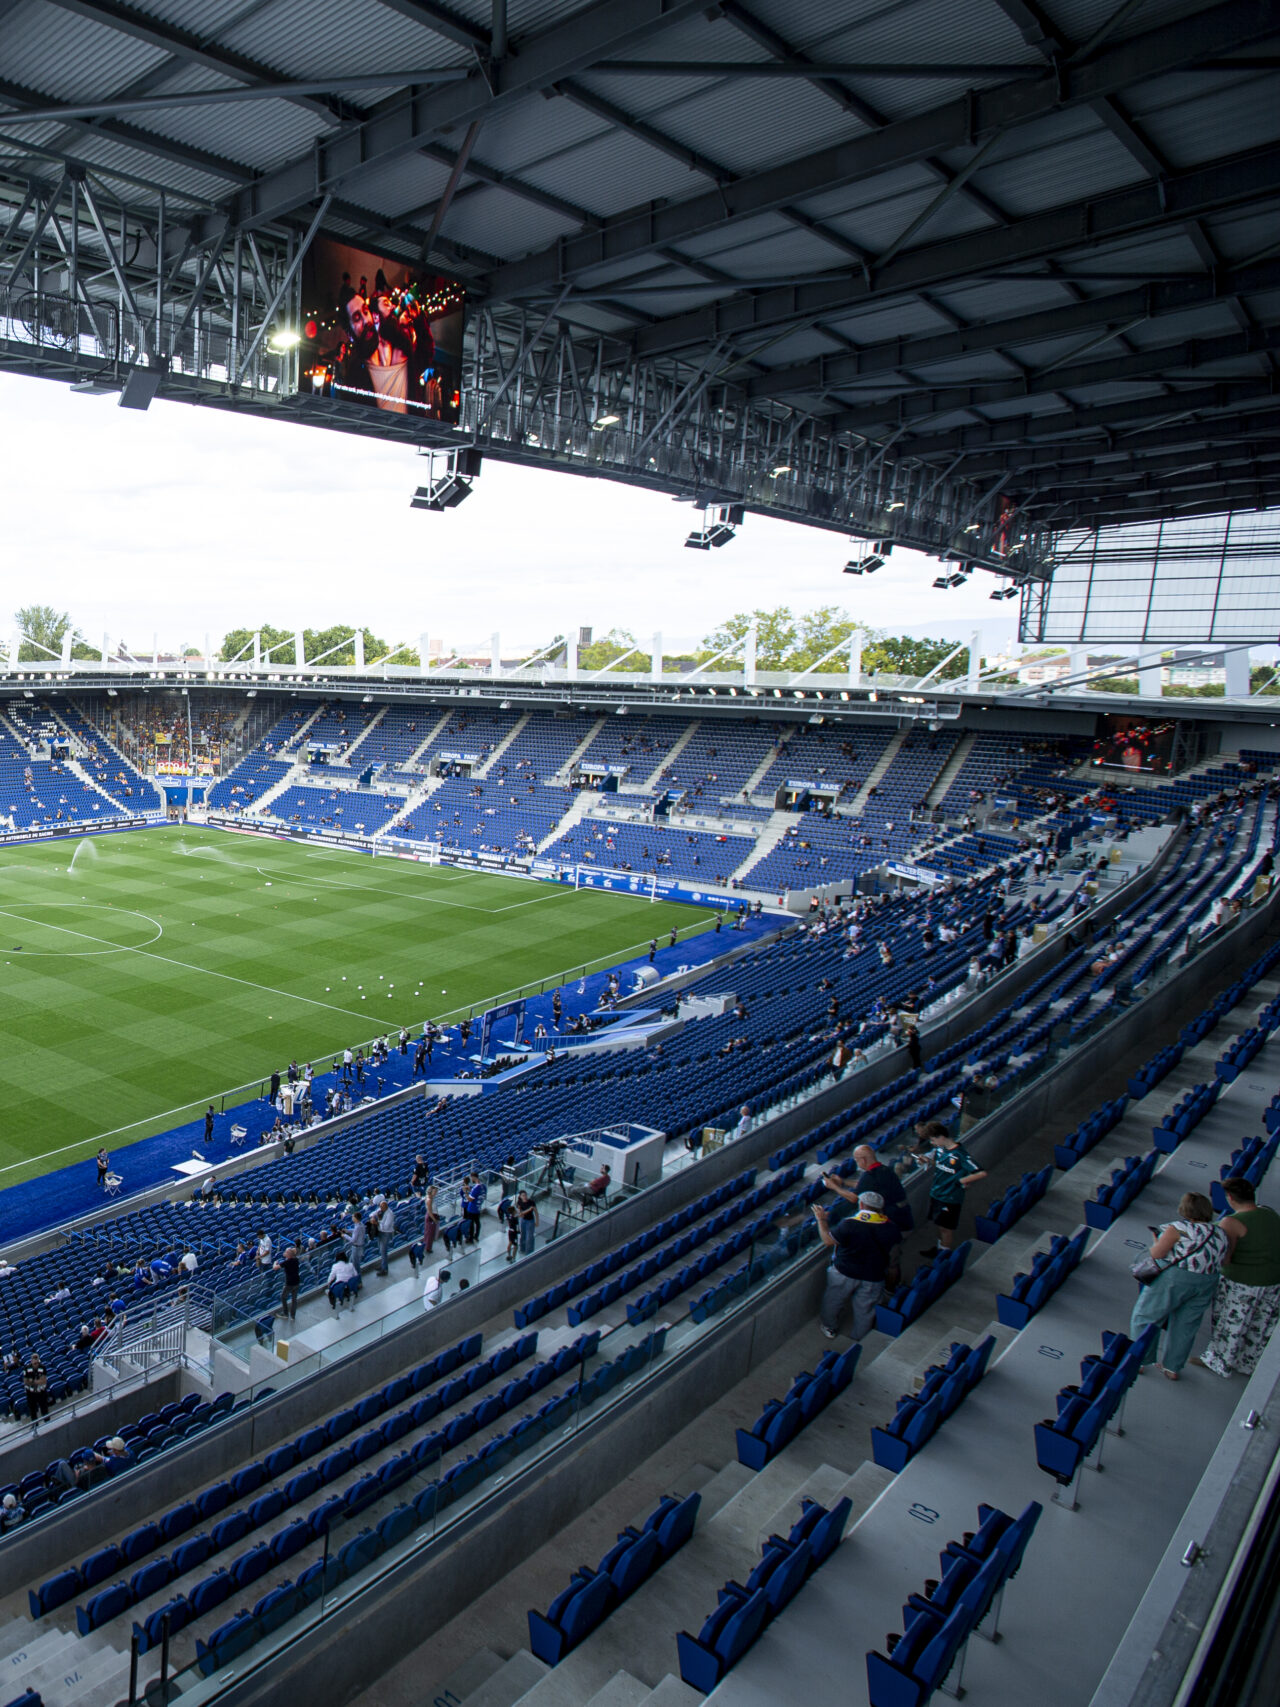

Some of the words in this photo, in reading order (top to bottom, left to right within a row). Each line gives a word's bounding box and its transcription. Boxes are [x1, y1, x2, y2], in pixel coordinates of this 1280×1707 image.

[581, 763, 606, 772] EUROPA
[608, 765, 627, 773] PARK
[787, 780, 817, 789] EUROPA
[820, 782, 841, 791] PARK
[1038, 1345, 1065, 1360] 03
[907, 1502, 940, 1525] 03
